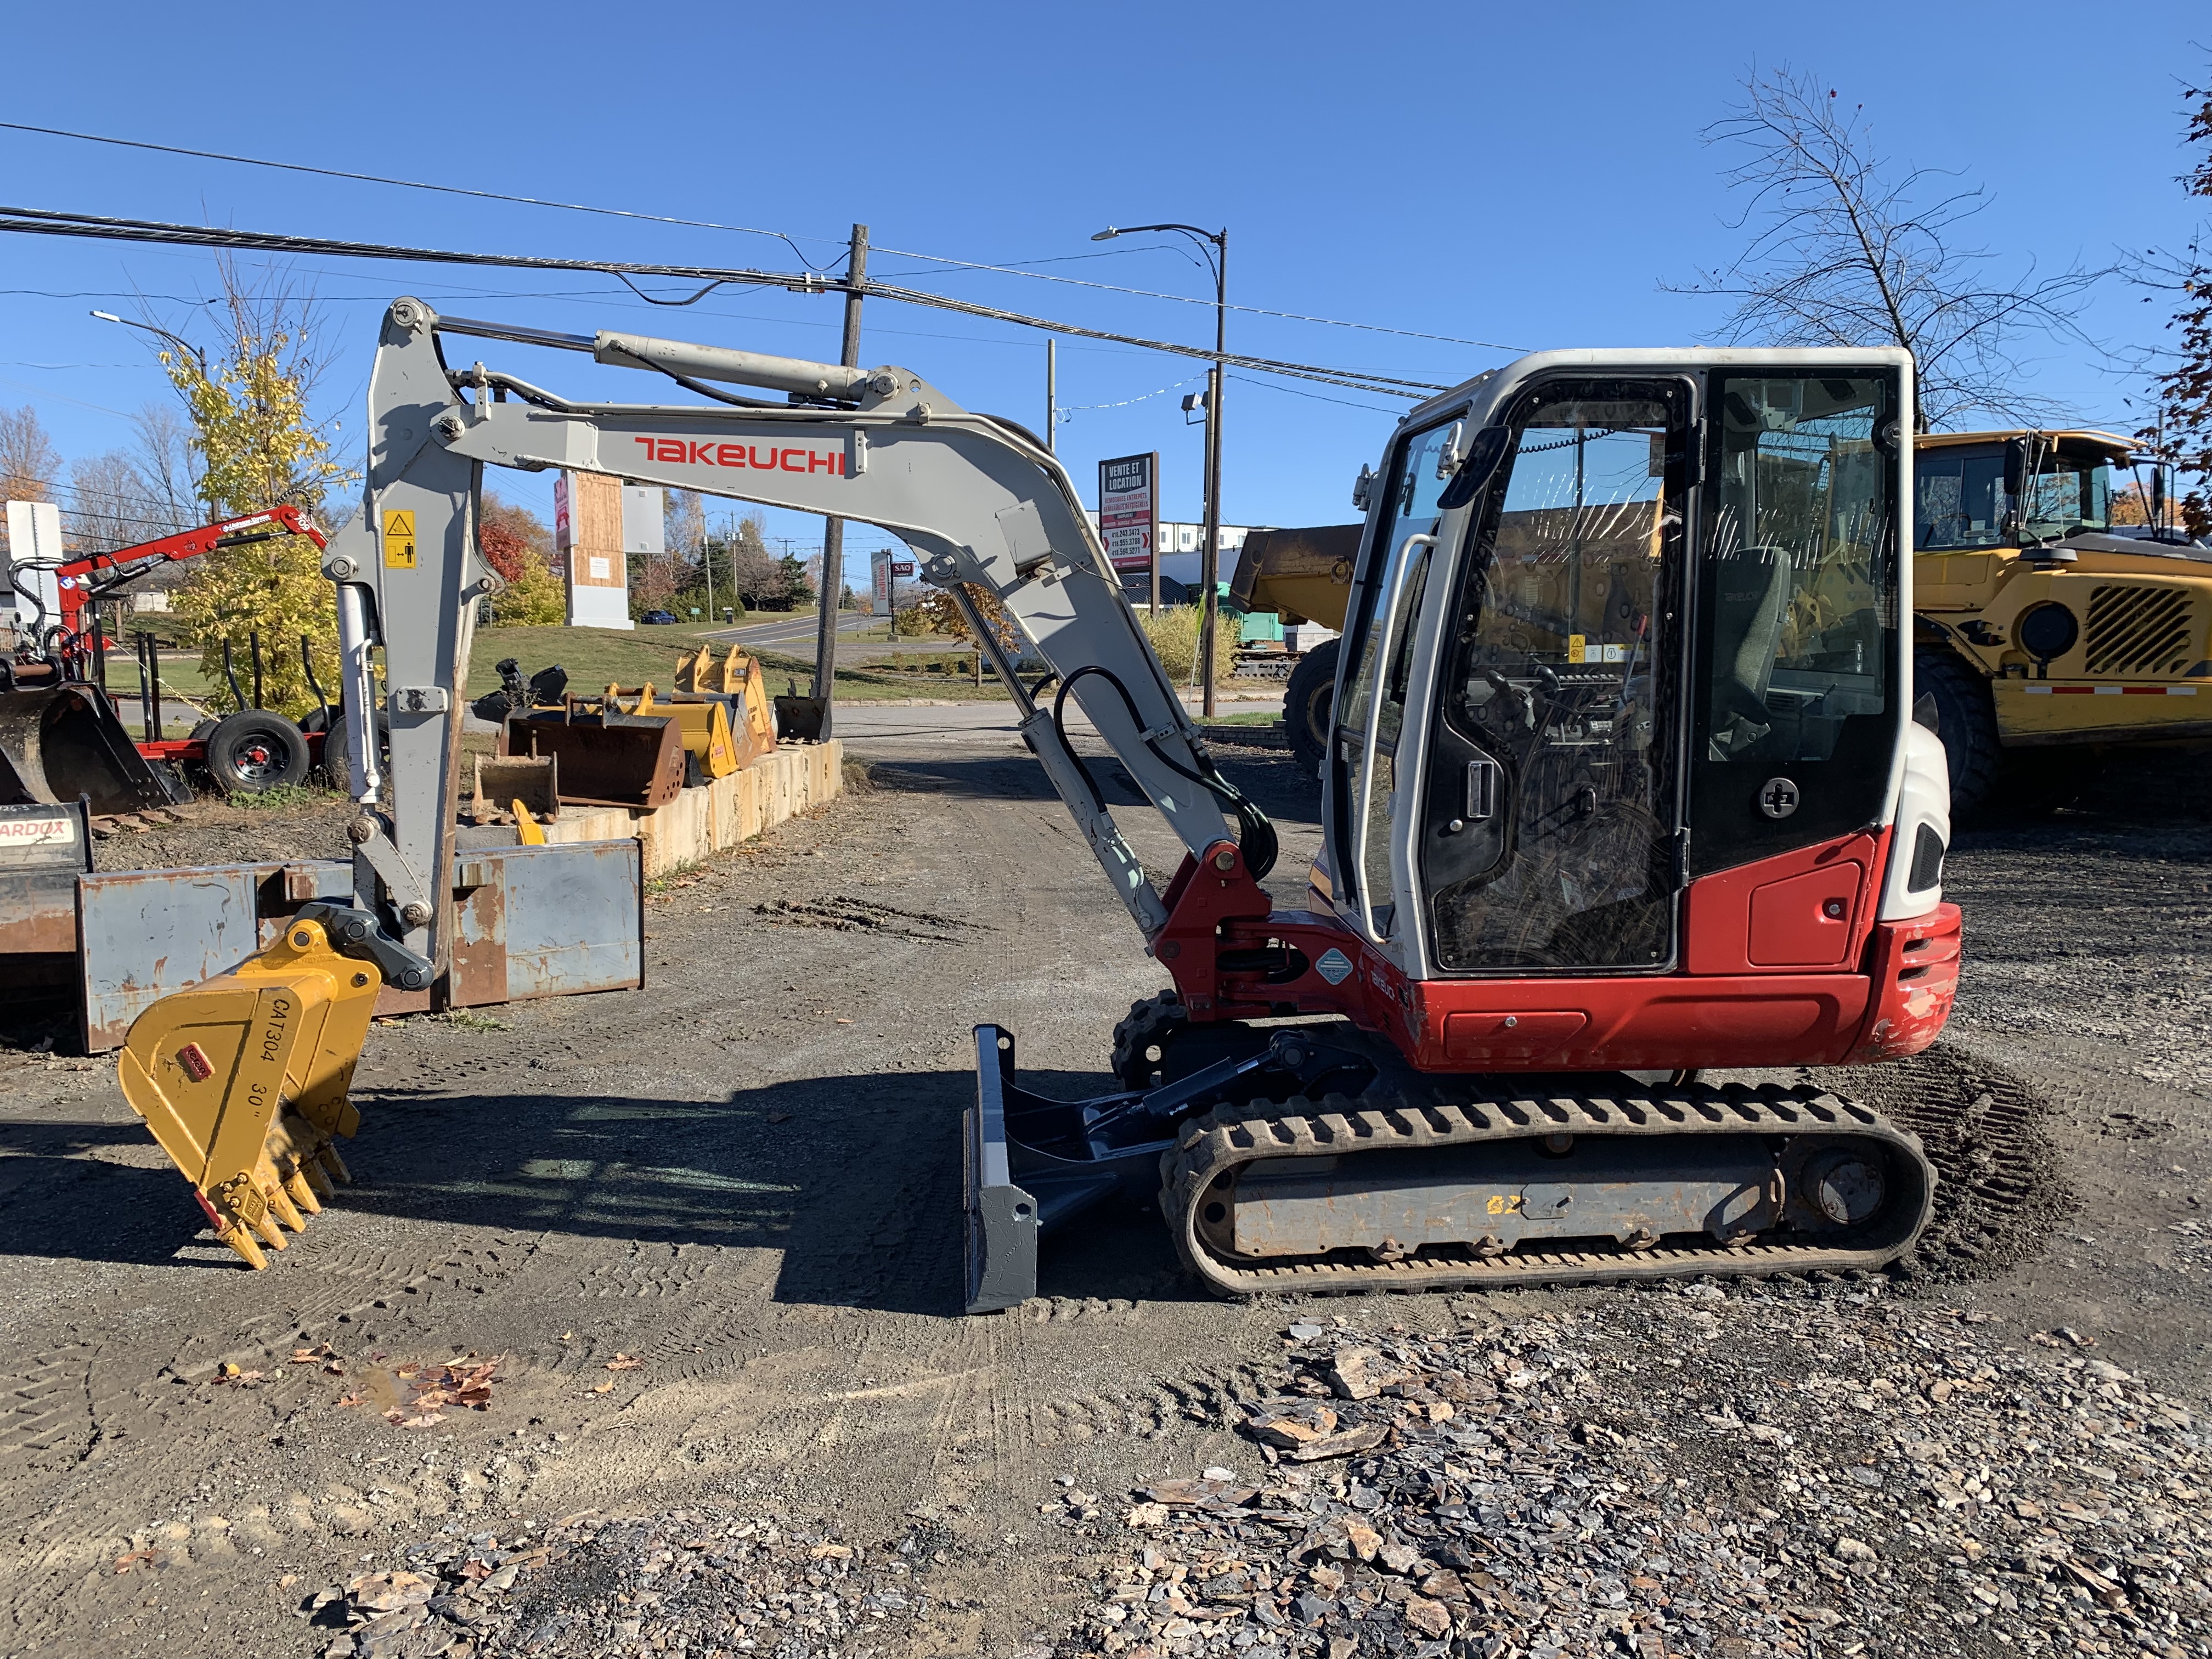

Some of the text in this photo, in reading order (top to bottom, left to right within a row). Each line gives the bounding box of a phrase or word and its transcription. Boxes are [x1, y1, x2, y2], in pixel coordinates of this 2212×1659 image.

[635, 437, 845, 476] TAKEUCHI
[1109, 462, 1139, 477] VENTE ET
[1109, 475, 1142, 490] LOCATION
[293, 514, 310, 531] 709
[1111, 528, 1139, 538] 418.243.3473
[260, 998, 290, 1062] CAT304
[187, 1048, 206, 1075] teran
